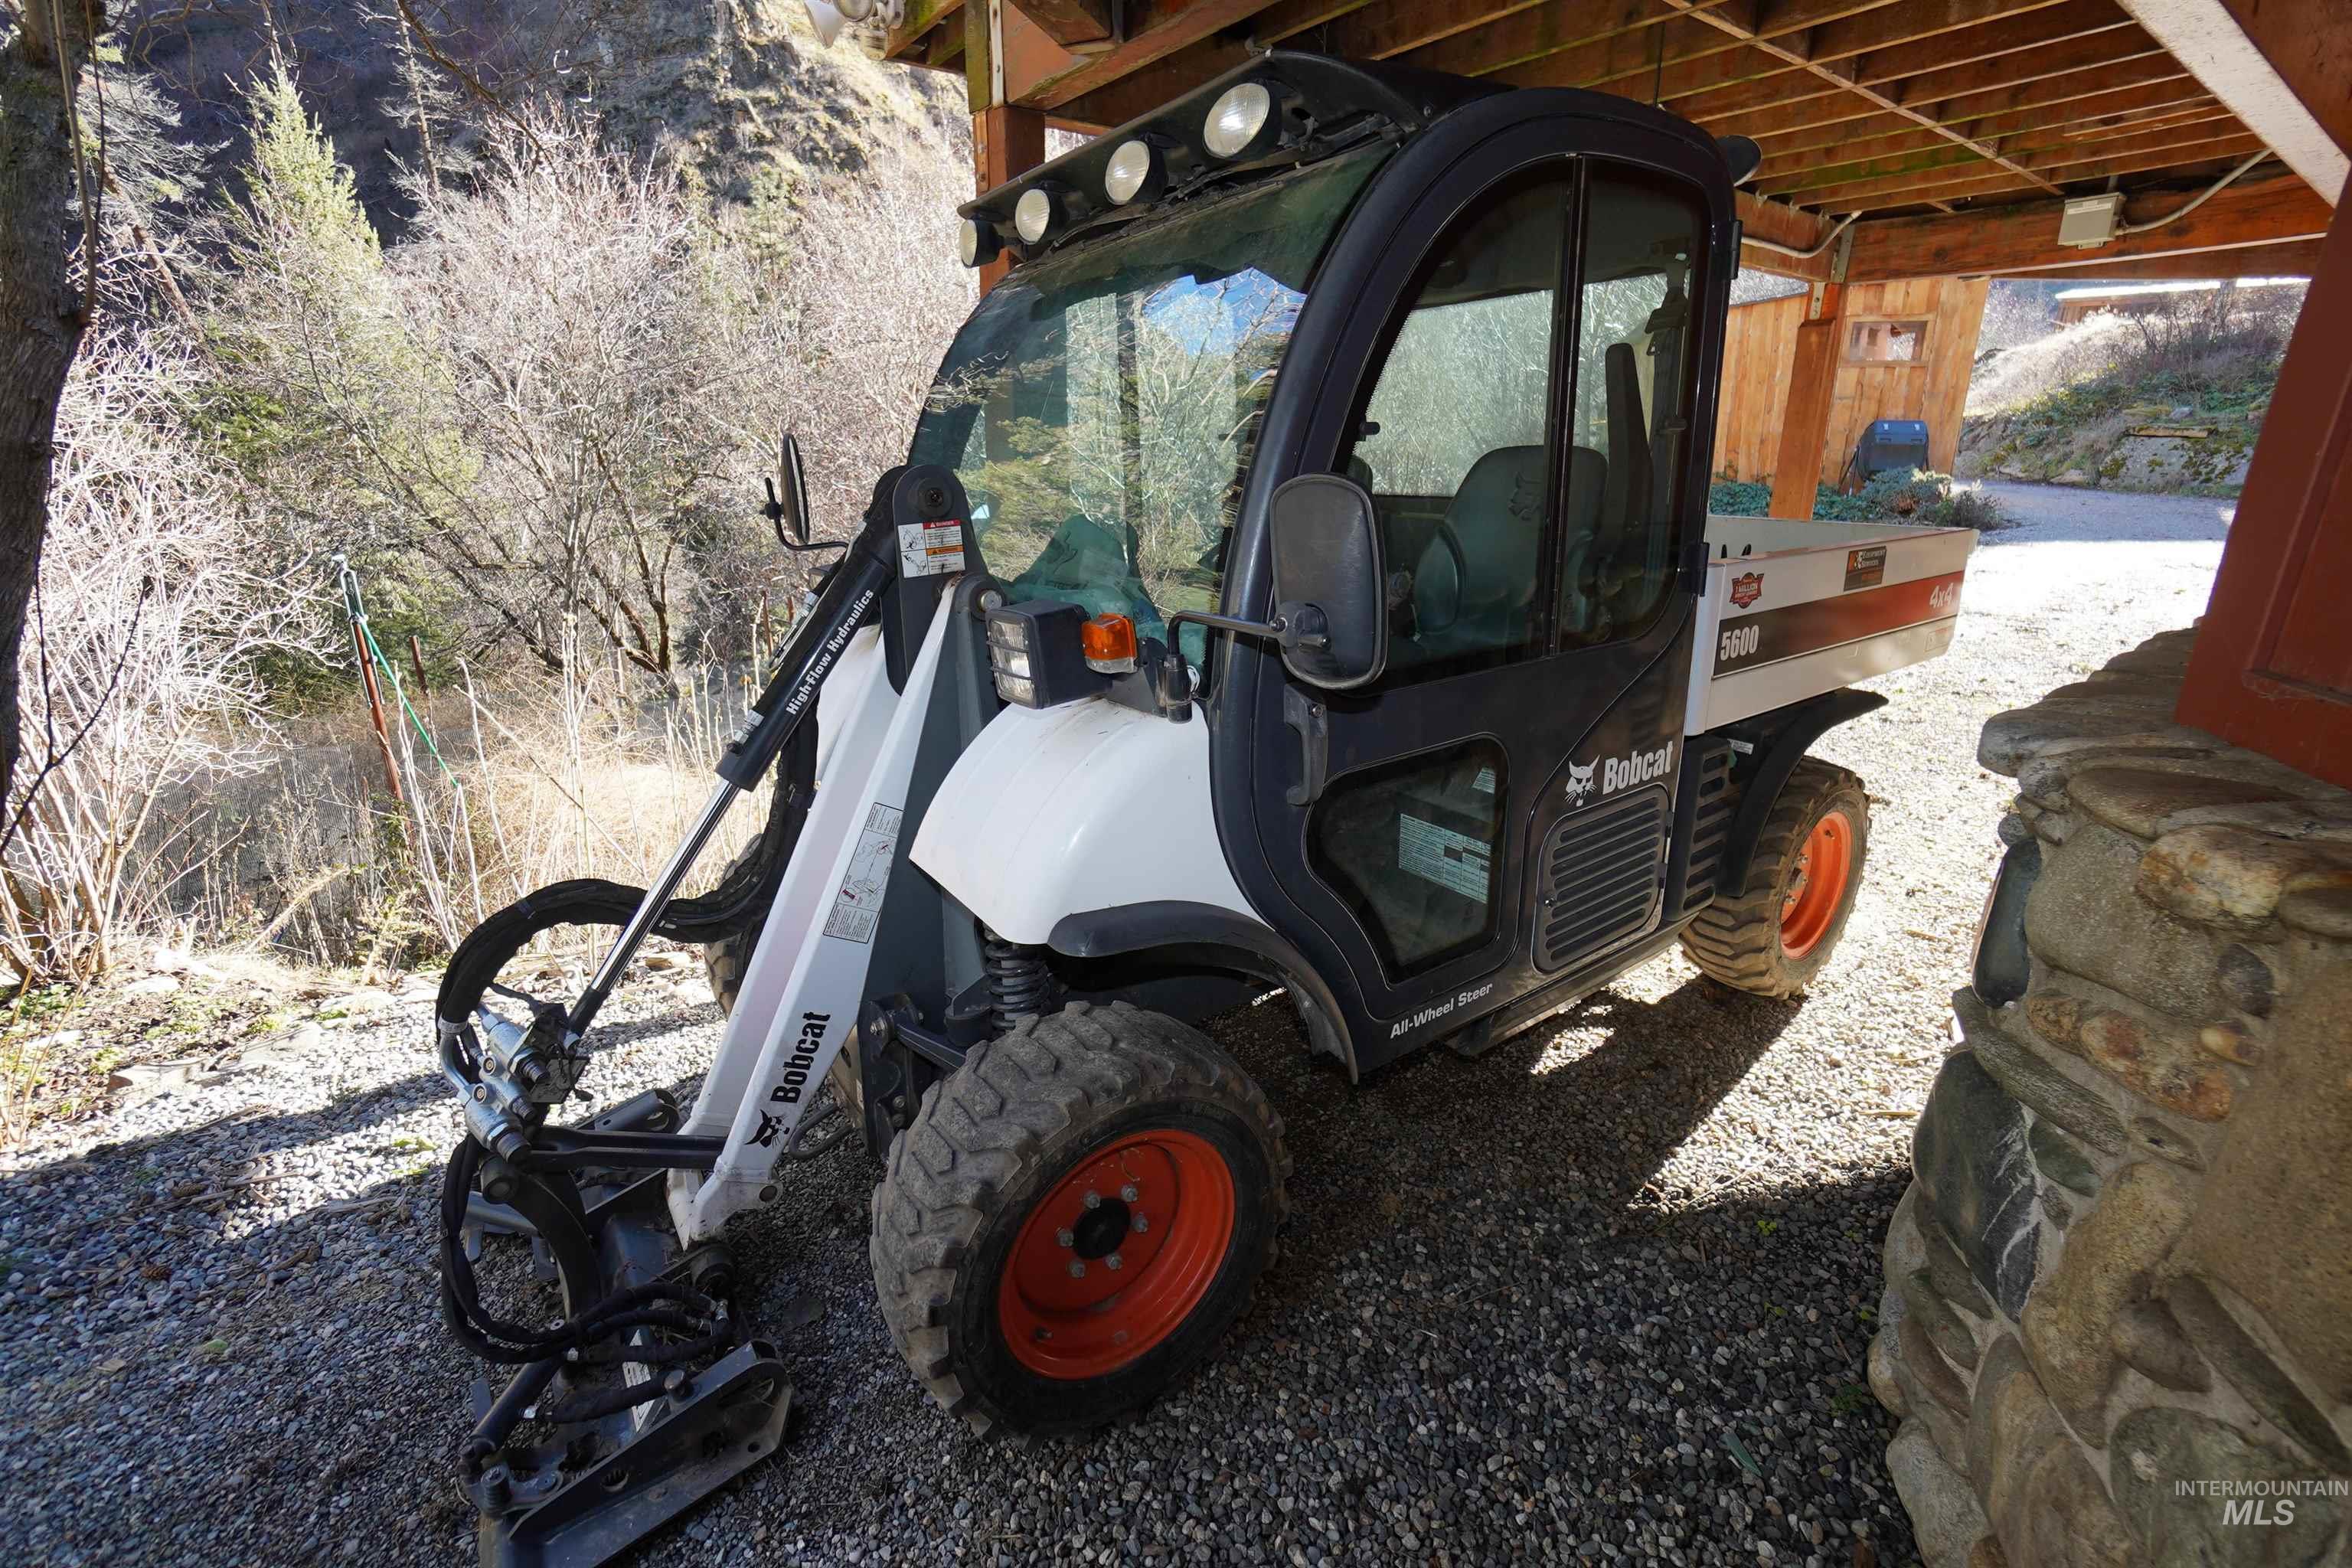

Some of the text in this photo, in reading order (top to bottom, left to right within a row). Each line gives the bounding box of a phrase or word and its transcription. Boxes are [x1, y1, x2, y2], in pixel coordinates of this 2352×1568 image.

[1929, 583, 1954, 608] 4x4
[786, 590, 874, 714] High-Flow Hydraulics
[1720, 625, 1759, 661] 5600
[1602, 740, 1674, 795] Bobcat
[1390, 983, 1493, 1039] All-Wheel Steer
[770, 1011, 831, 1103] Bobcat
